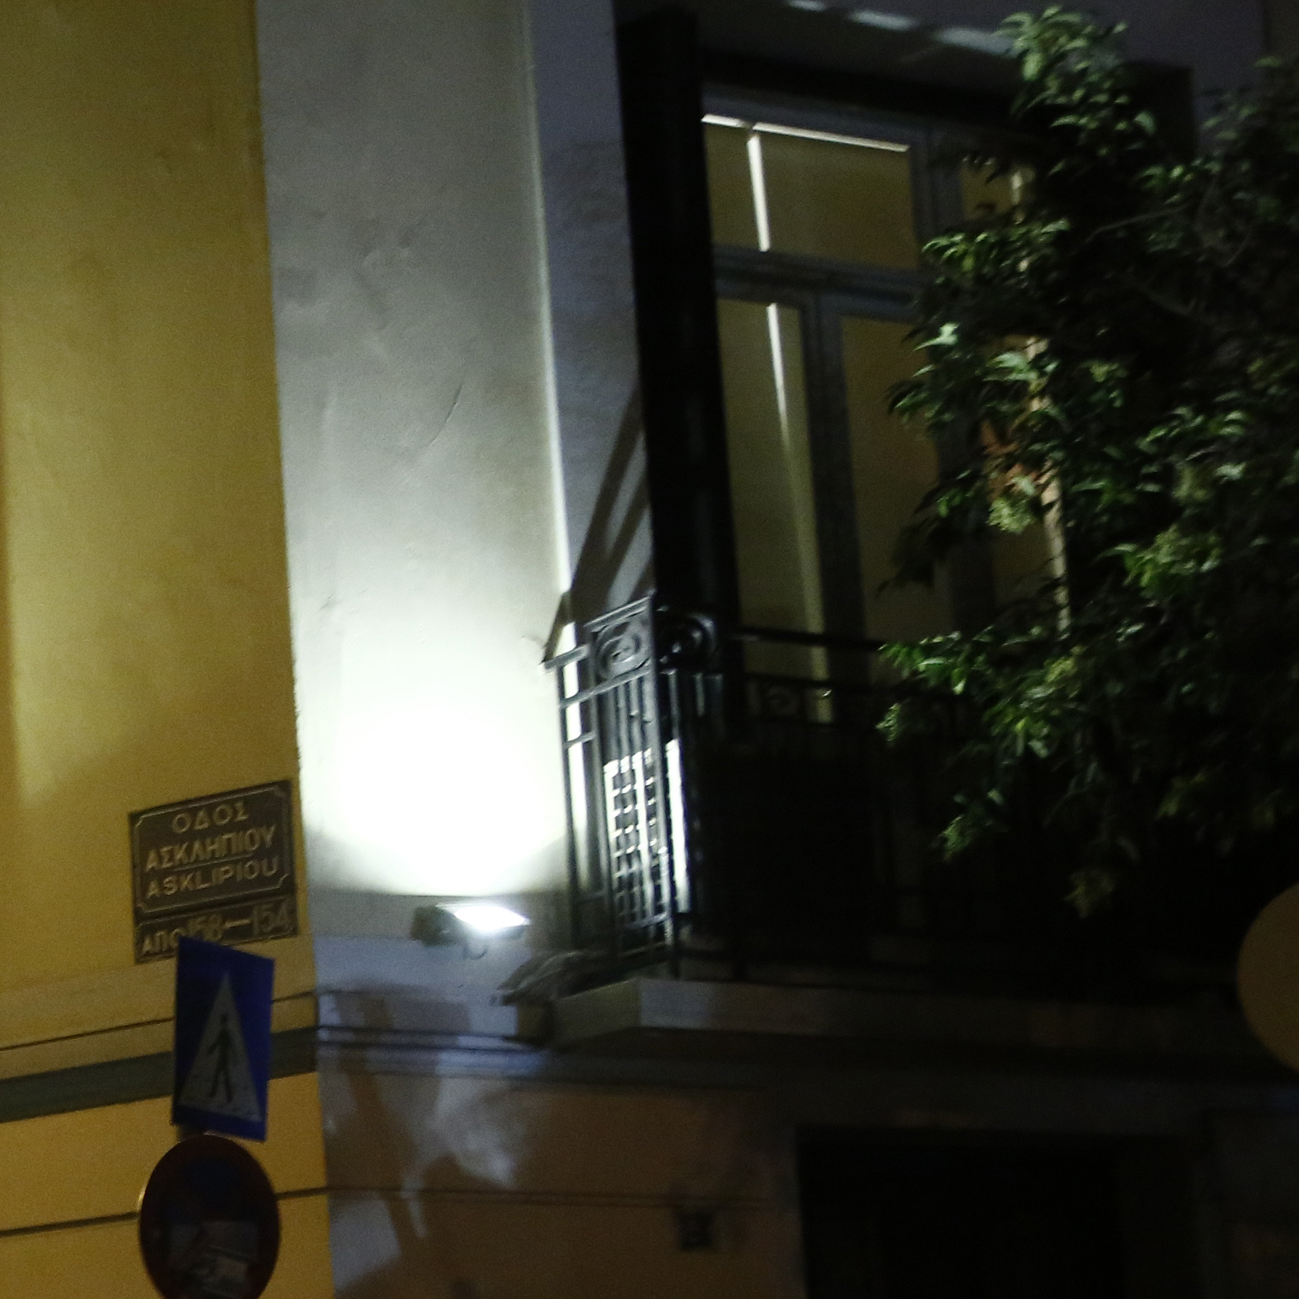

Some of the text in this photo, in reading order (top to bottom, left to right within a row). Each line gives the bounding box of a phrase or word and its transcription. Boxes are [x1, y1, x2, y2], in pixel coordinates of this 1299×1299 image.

[171, 801, 250, 834] ΟΔΟΣ
[144, 824, 277, 873] ΑΣΚΛΗΠΙΟΥ
[146, 857, 280, 899] ASKLIPIOU
